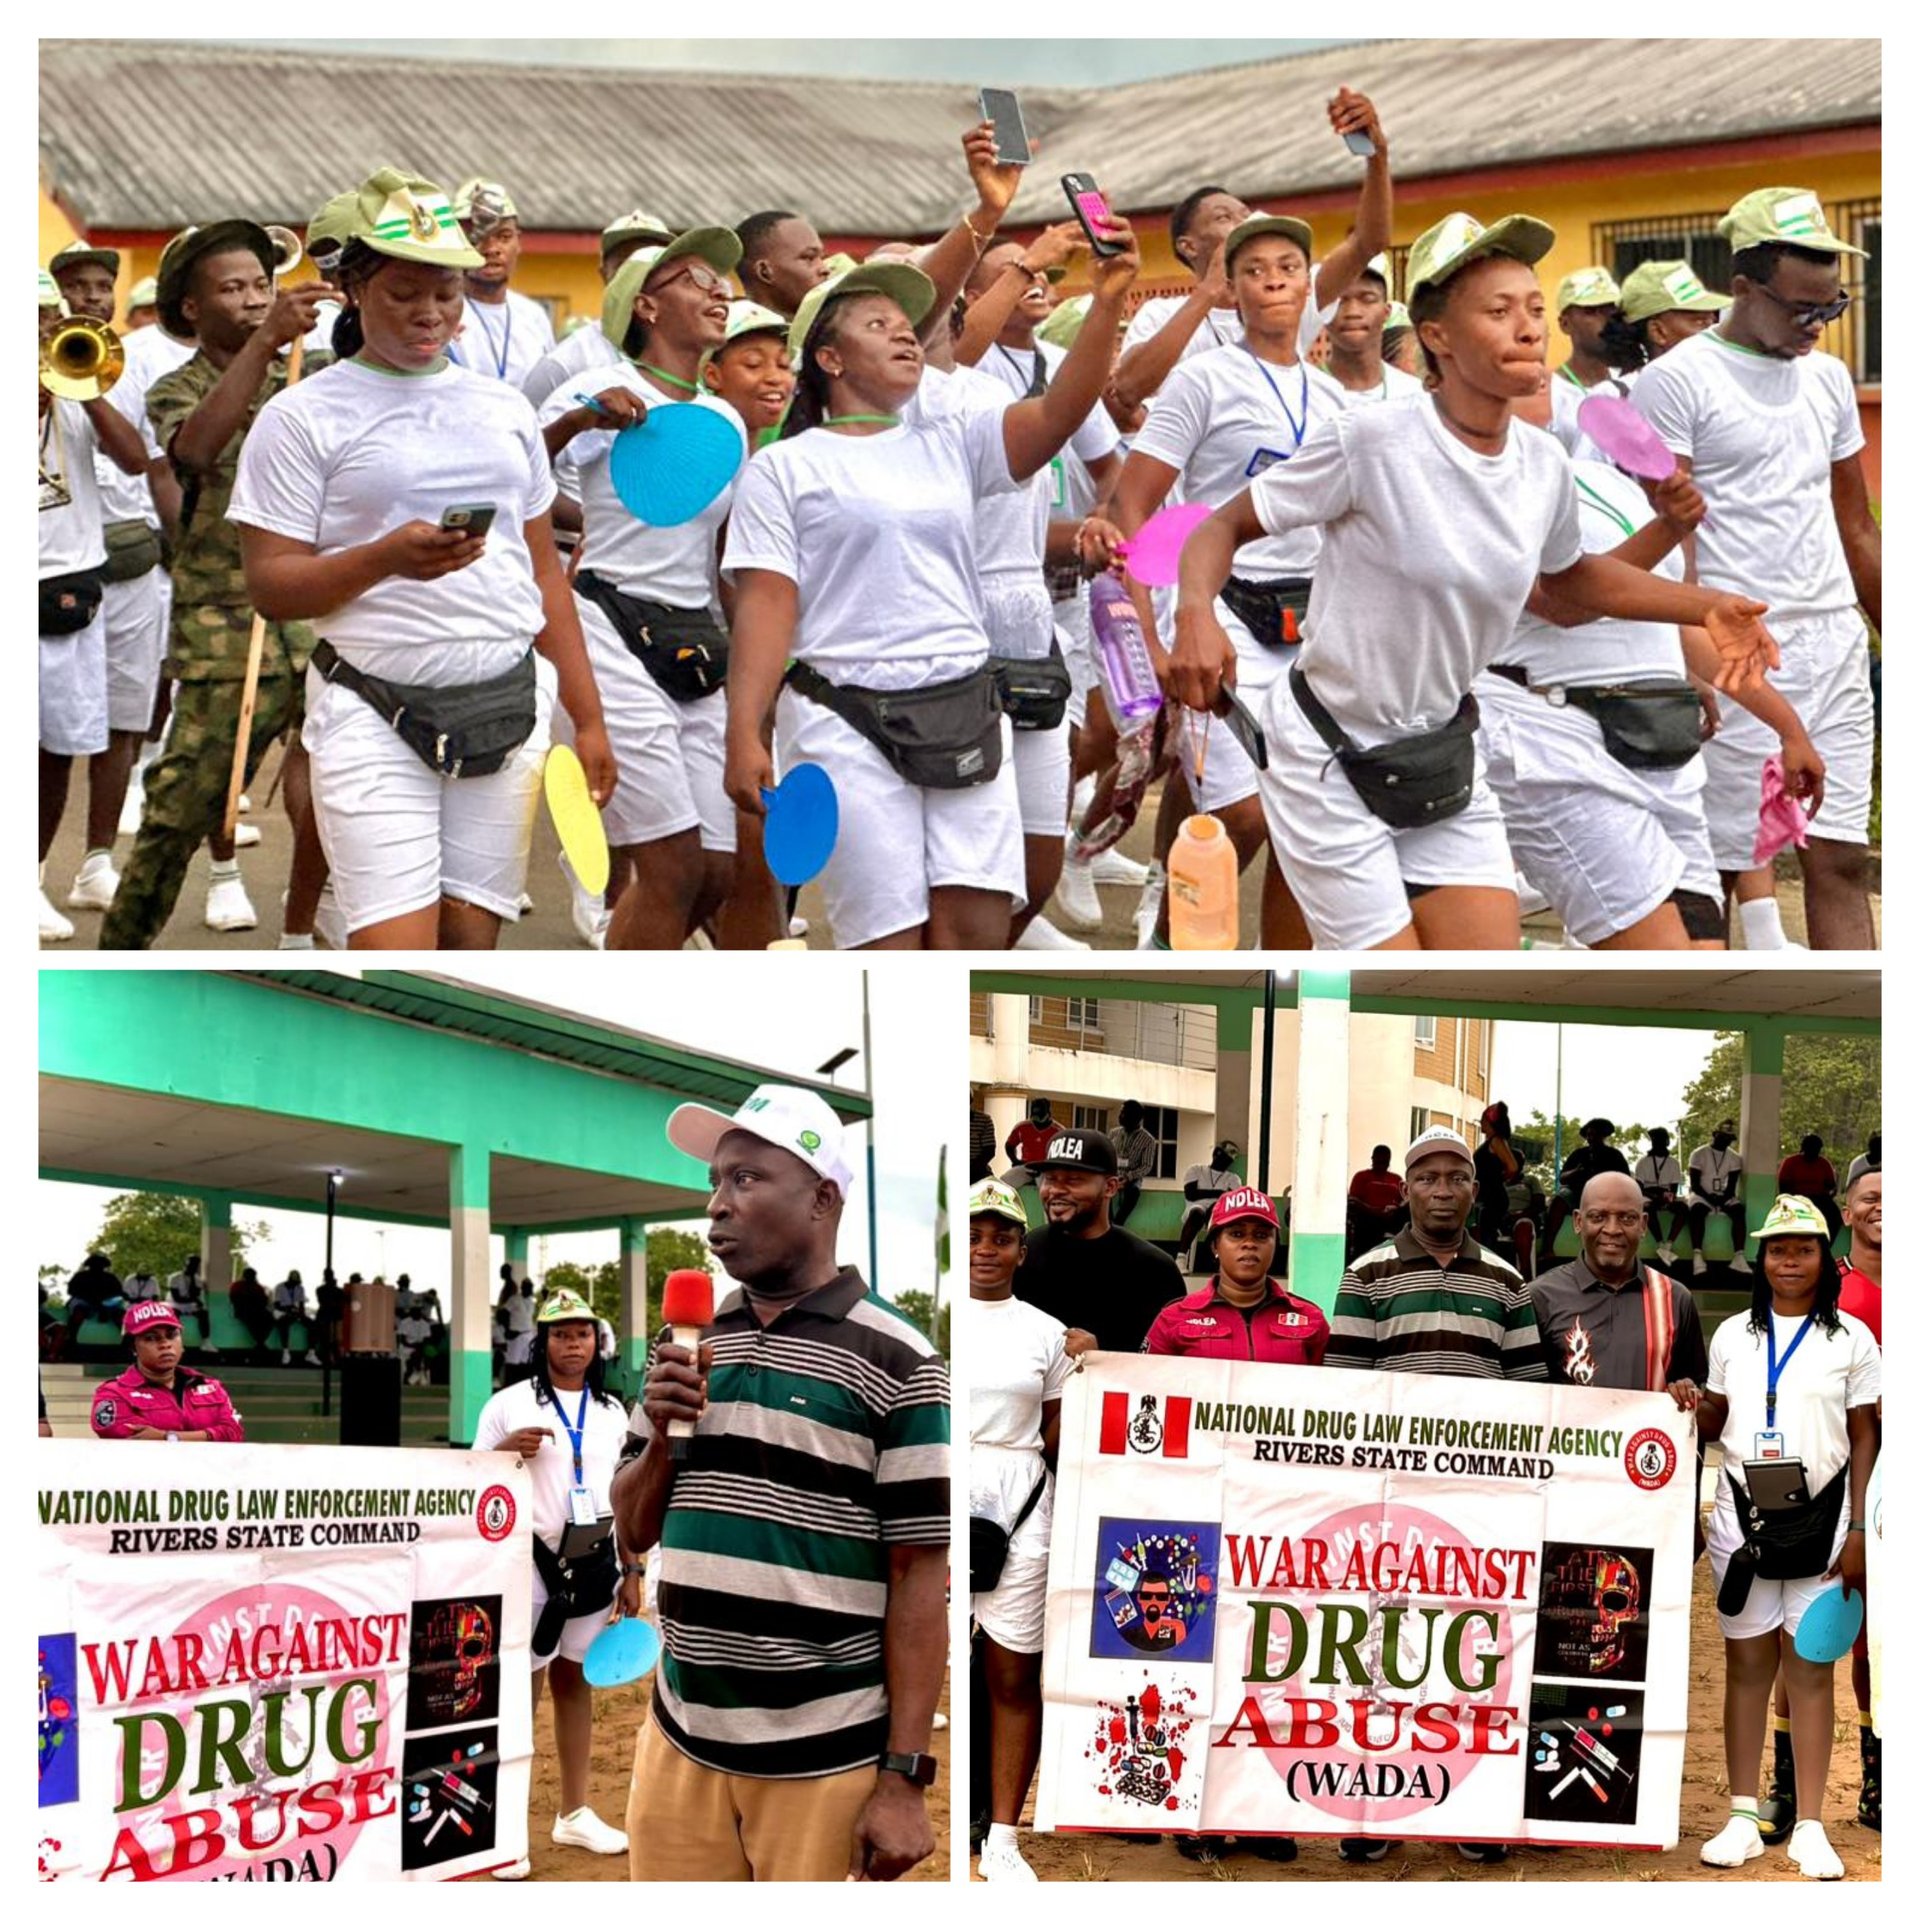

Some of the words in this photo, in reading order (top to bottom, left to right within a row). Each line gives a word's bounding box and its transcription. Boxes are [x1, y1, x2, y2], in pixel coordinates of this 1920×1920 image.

[1225, 1190, 1270, 1212] NDLEA
[1195, 1402, 1295, 1436] NATIONAL
[1302, 1409, 1356, 1440] DRUG
[1364, 1413, 1403, 1443] LAW
[1409, 1417, 1544, 1453] ENFORCEMENT
[1547, 1427, 1623, 1458] AGENCY
[1254, 1440, 1344, 1466] RIVERS
[1352, 1447, 1427, 1471] STATE
[1434, 1452, 1554, 1480] COMMAND
[38, 1490, 160, 1524] NATIONAL
[169, 1490, 229, 1522] DRUG
[237, 1489, 278, 1520] LAW
[285, 1489, 410, 1518] ENFORCEMENT
[414, 1489, 475, 1515] AGENCY
[109, 1527, 217, 1553] RIVERS
[226, 1524, 304, 1550] STATE
[310, 1522, 420, 1546] COMMAND
[1225, 1535, 1331, 1590] WAR
[1339, 1541, 1535, 1600] AGAINST
[81, 1632, 210, 1704] WAR
[217, 1613, 407, 1685] AGAINST
[1242, 1600, 1504, 1693] DRUG
[113, 1679, 383, 1813] DRUG
[1211, 1697, 1519, 1755] ABUSE
[1287, 1760, 1450, 1805] (WADA)
[98, 1767, 396, 1881] ABUSE
